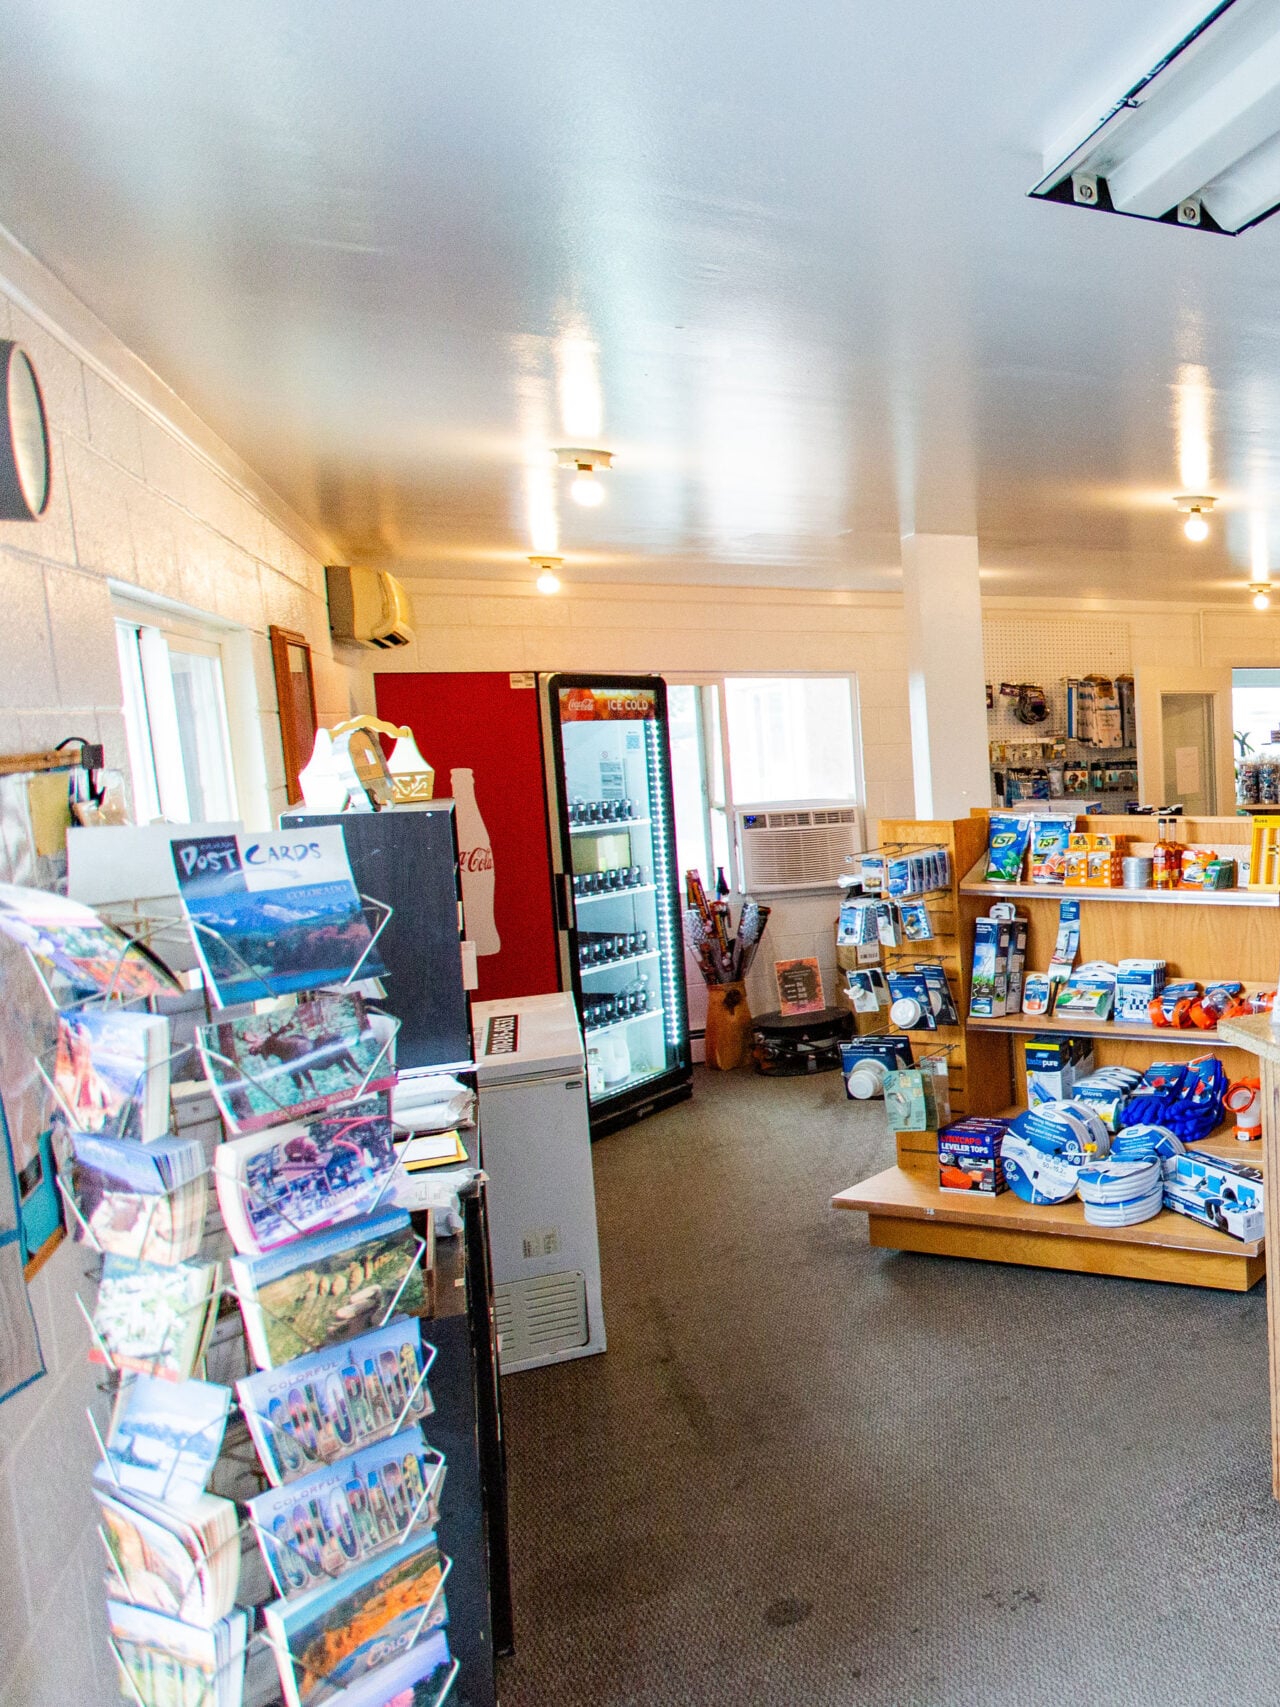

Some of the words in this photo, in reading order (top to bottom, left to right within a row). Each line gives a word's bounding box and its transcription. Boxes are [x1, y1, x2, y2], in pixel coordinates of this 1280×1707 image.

[607, 700, 623, 711] ICE
[624, 700, 649, 711] COLD
[1081, 1090, 1103, 1098] Gloves
[941, 1142, 970, 1152] LEVELER
[970, 1145, 989, 1155] TOPS
[268, 1361, 339, 1394] COLORFUL
[268, 1342, 426, 1472] COLORADO
[272, 1475, 342, 1512] COLORFUL
[272, 1452, 430, 1590] COLORADO
